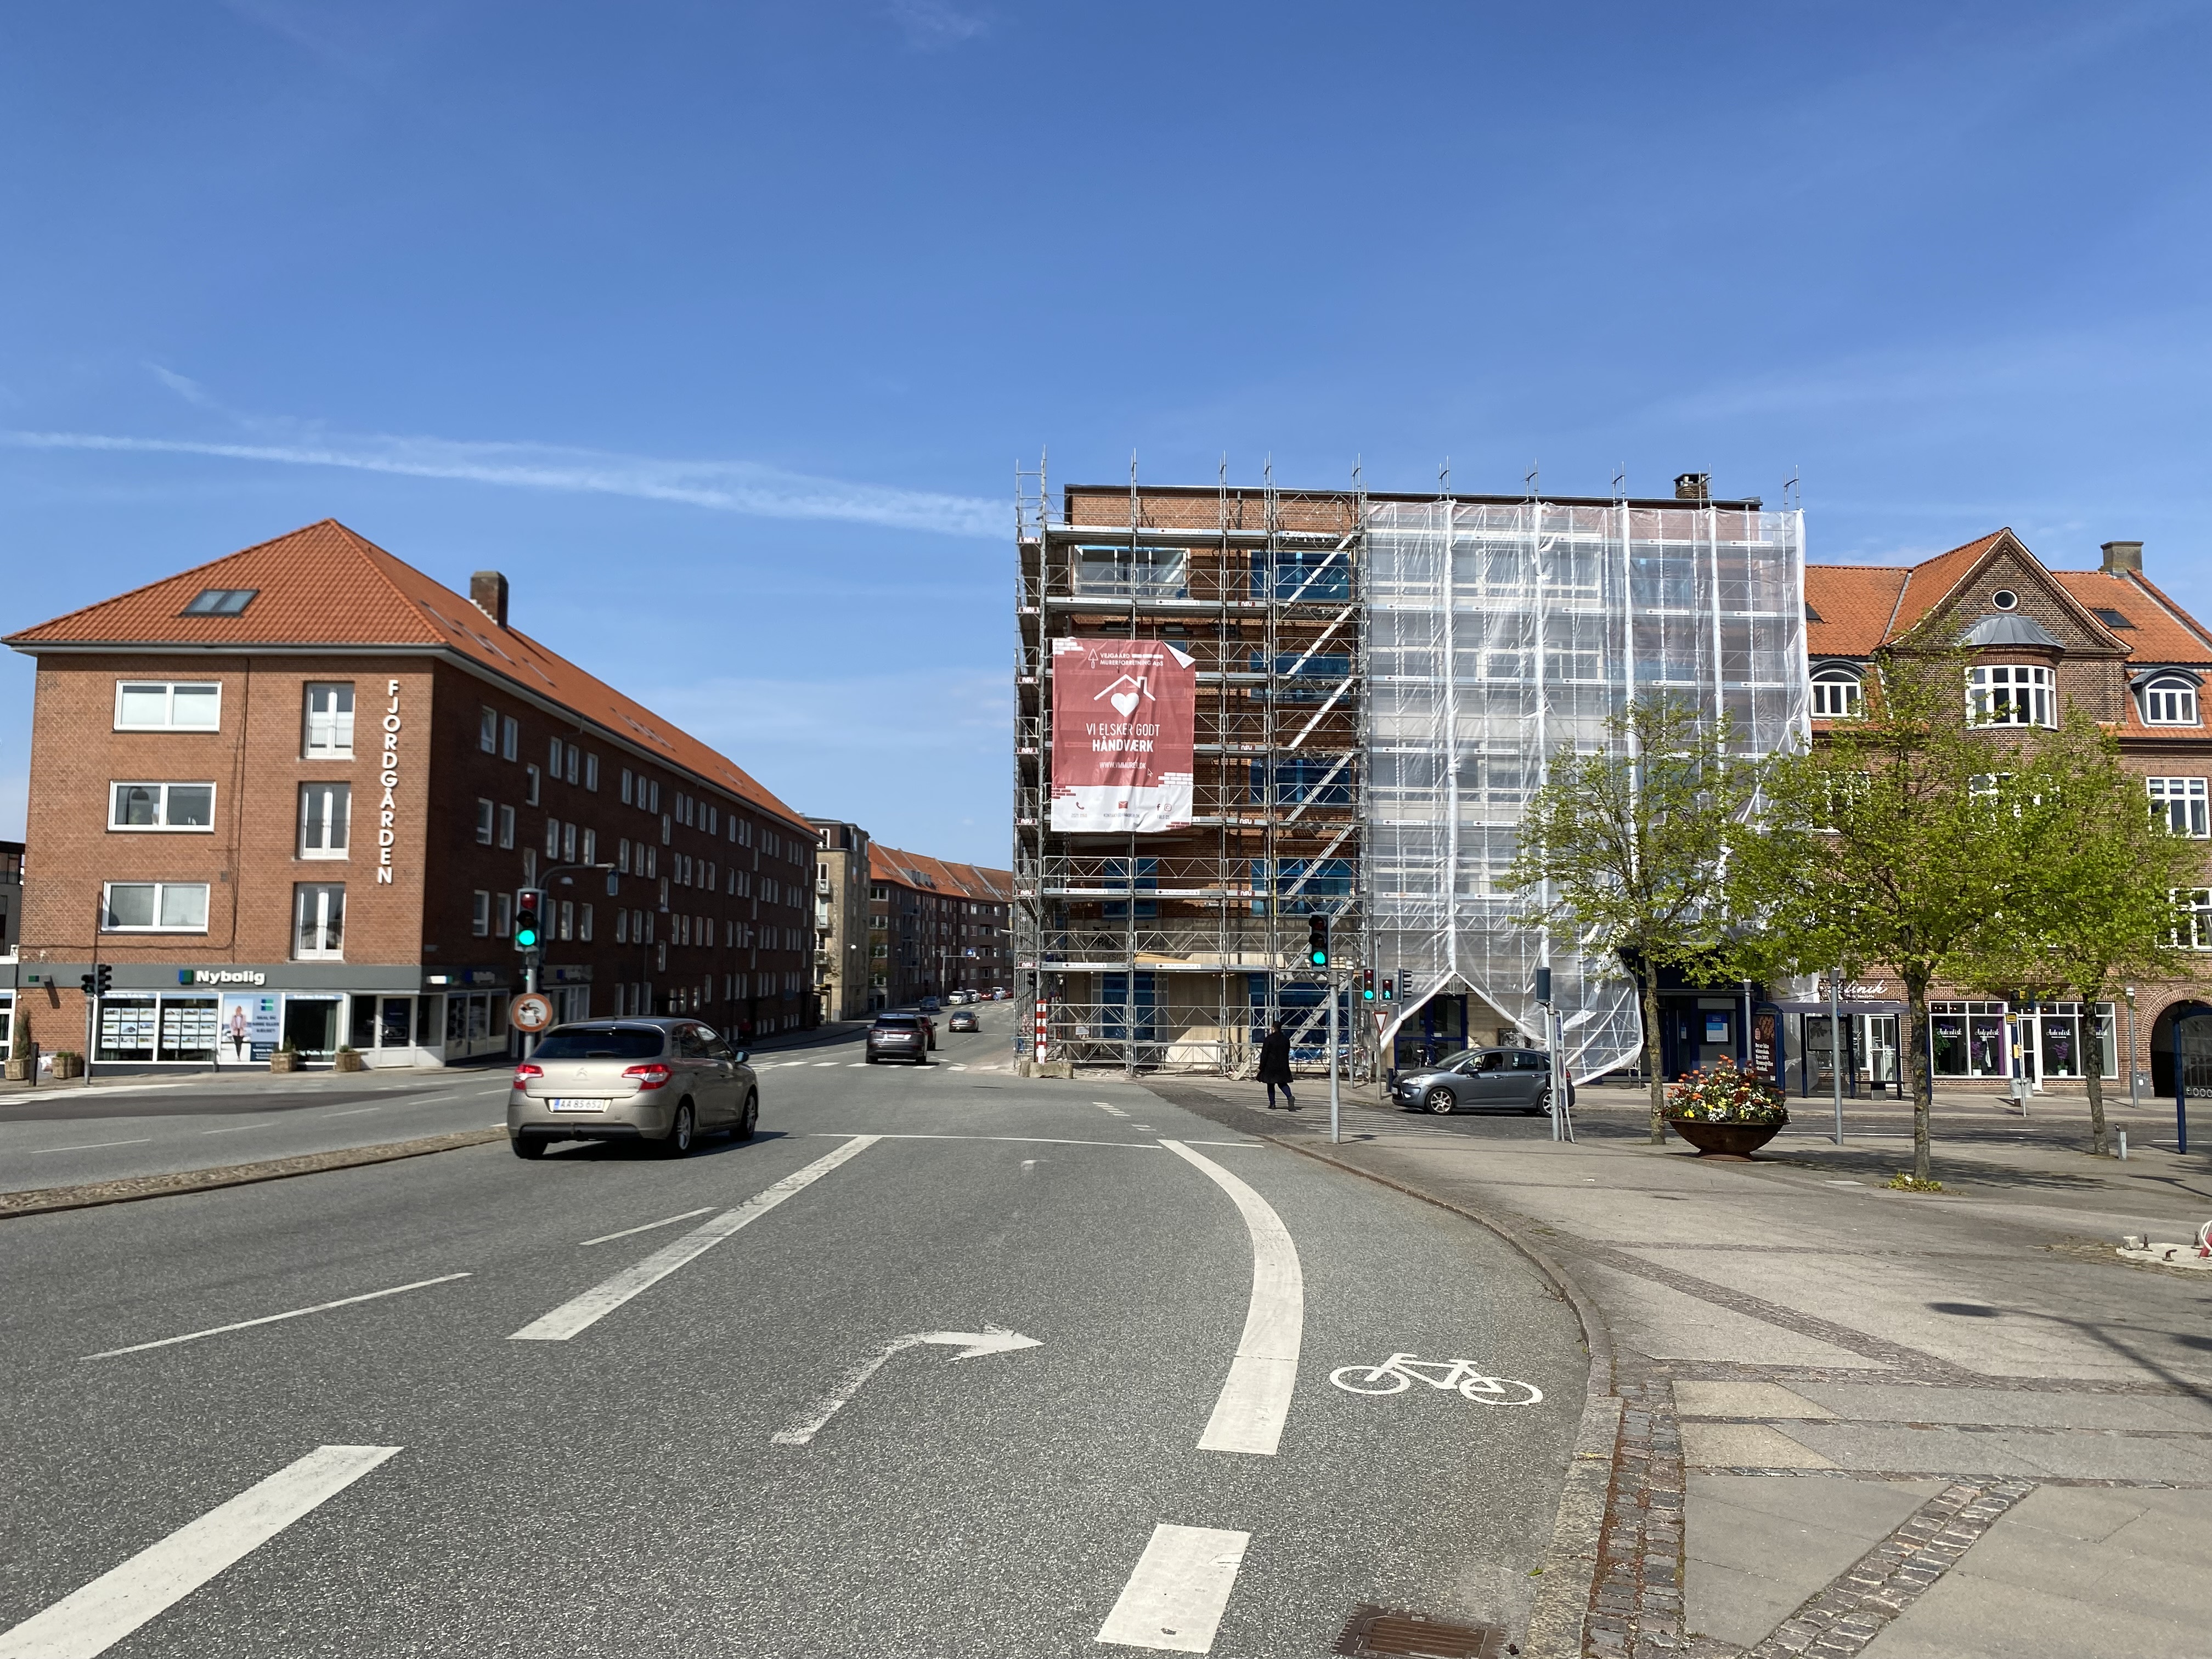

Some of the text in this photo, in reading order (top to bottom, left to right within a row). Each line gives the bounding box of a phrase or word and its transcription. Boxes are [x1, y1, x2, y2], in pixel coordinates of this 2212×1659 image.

[1086, 723, 1160, 737] VI ELSKER GODT
[1092, 735, 1154, 752] HÅNDVÆRK
[377, 679, 400, 884] FJORDGÅRDEN
[196, 970, 266, 986] Nybolig
[2096, 1028, 2108, 1036] ntisk
[560, 1100, 571, 1108] AA
[573, 1100, 584, 1108] 85
